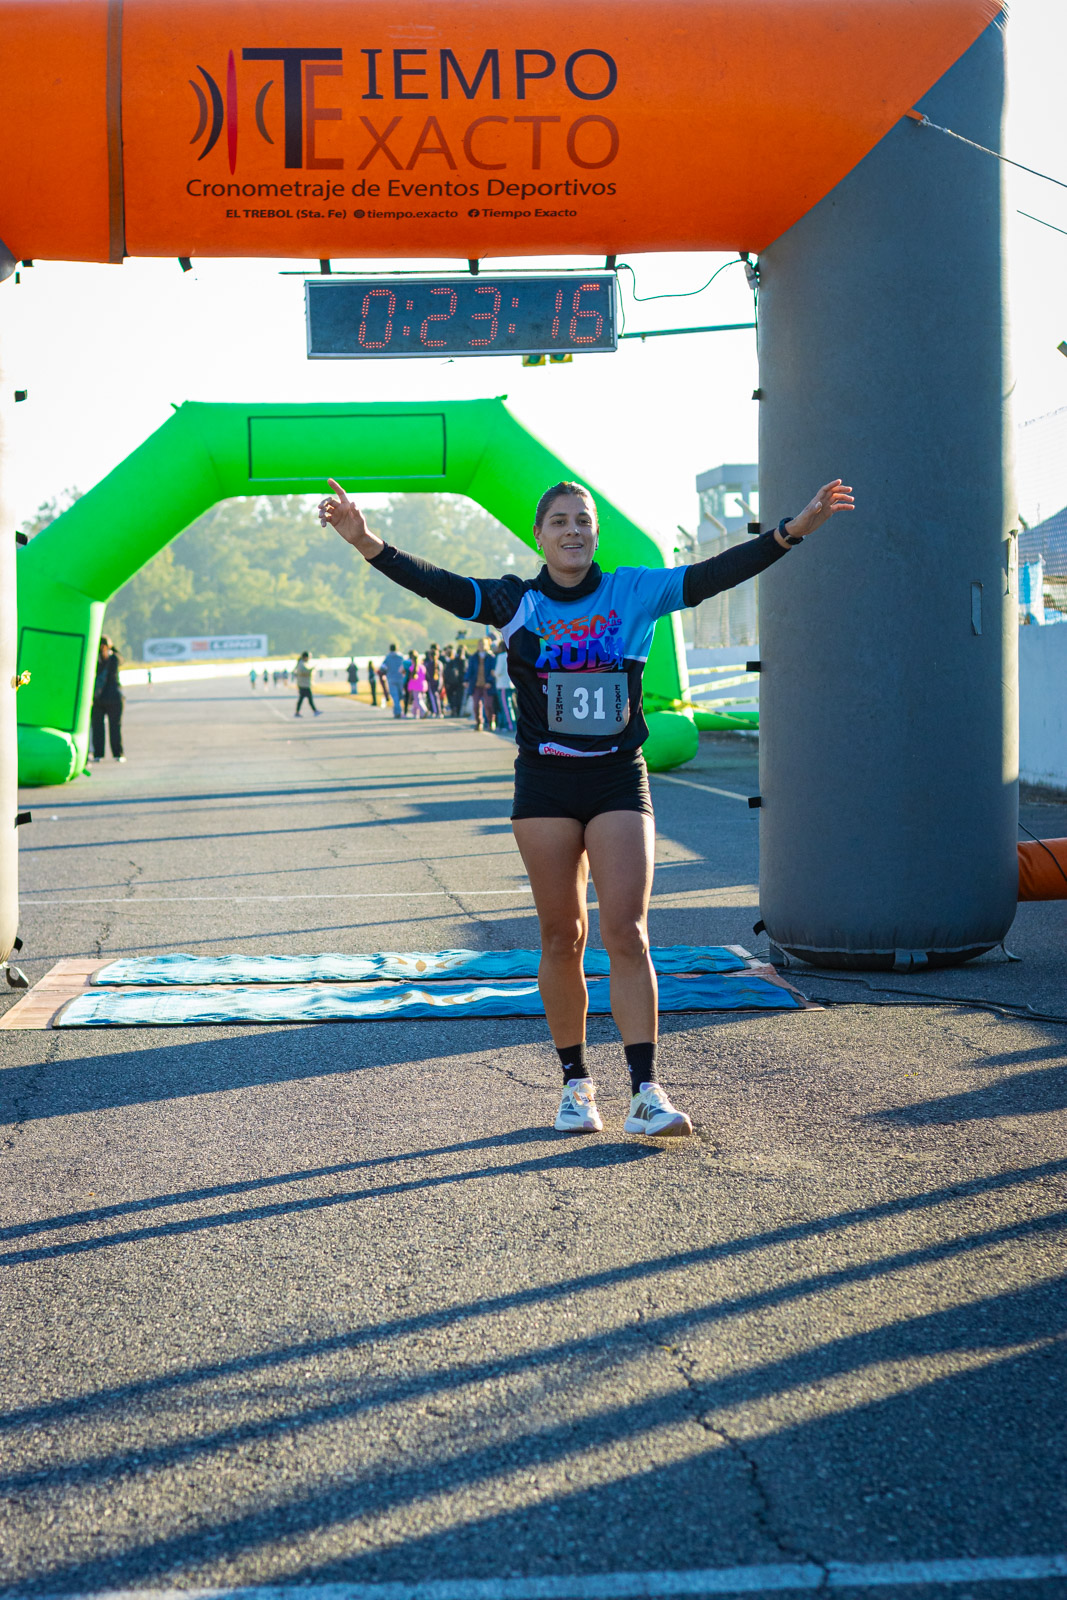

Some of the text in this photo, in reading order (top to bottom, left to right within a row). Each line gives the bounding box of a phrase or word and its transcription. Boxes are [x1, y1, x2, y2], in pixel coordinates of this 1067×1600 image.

[186, 178, 617, 201] Cronometraje de Eventos Deportivos
[226, 209, 347, 219] EL TREBOL (Sta. Fe)
[367, 209, 458, 220] tiempo.exacto
[482, 208, 577, 219] Tiempo Exacto
[555, 684, 563, 722] TIEMPO
[572, 687, 606, 720] 31
[614, 684, 622, 722] EXACTO
